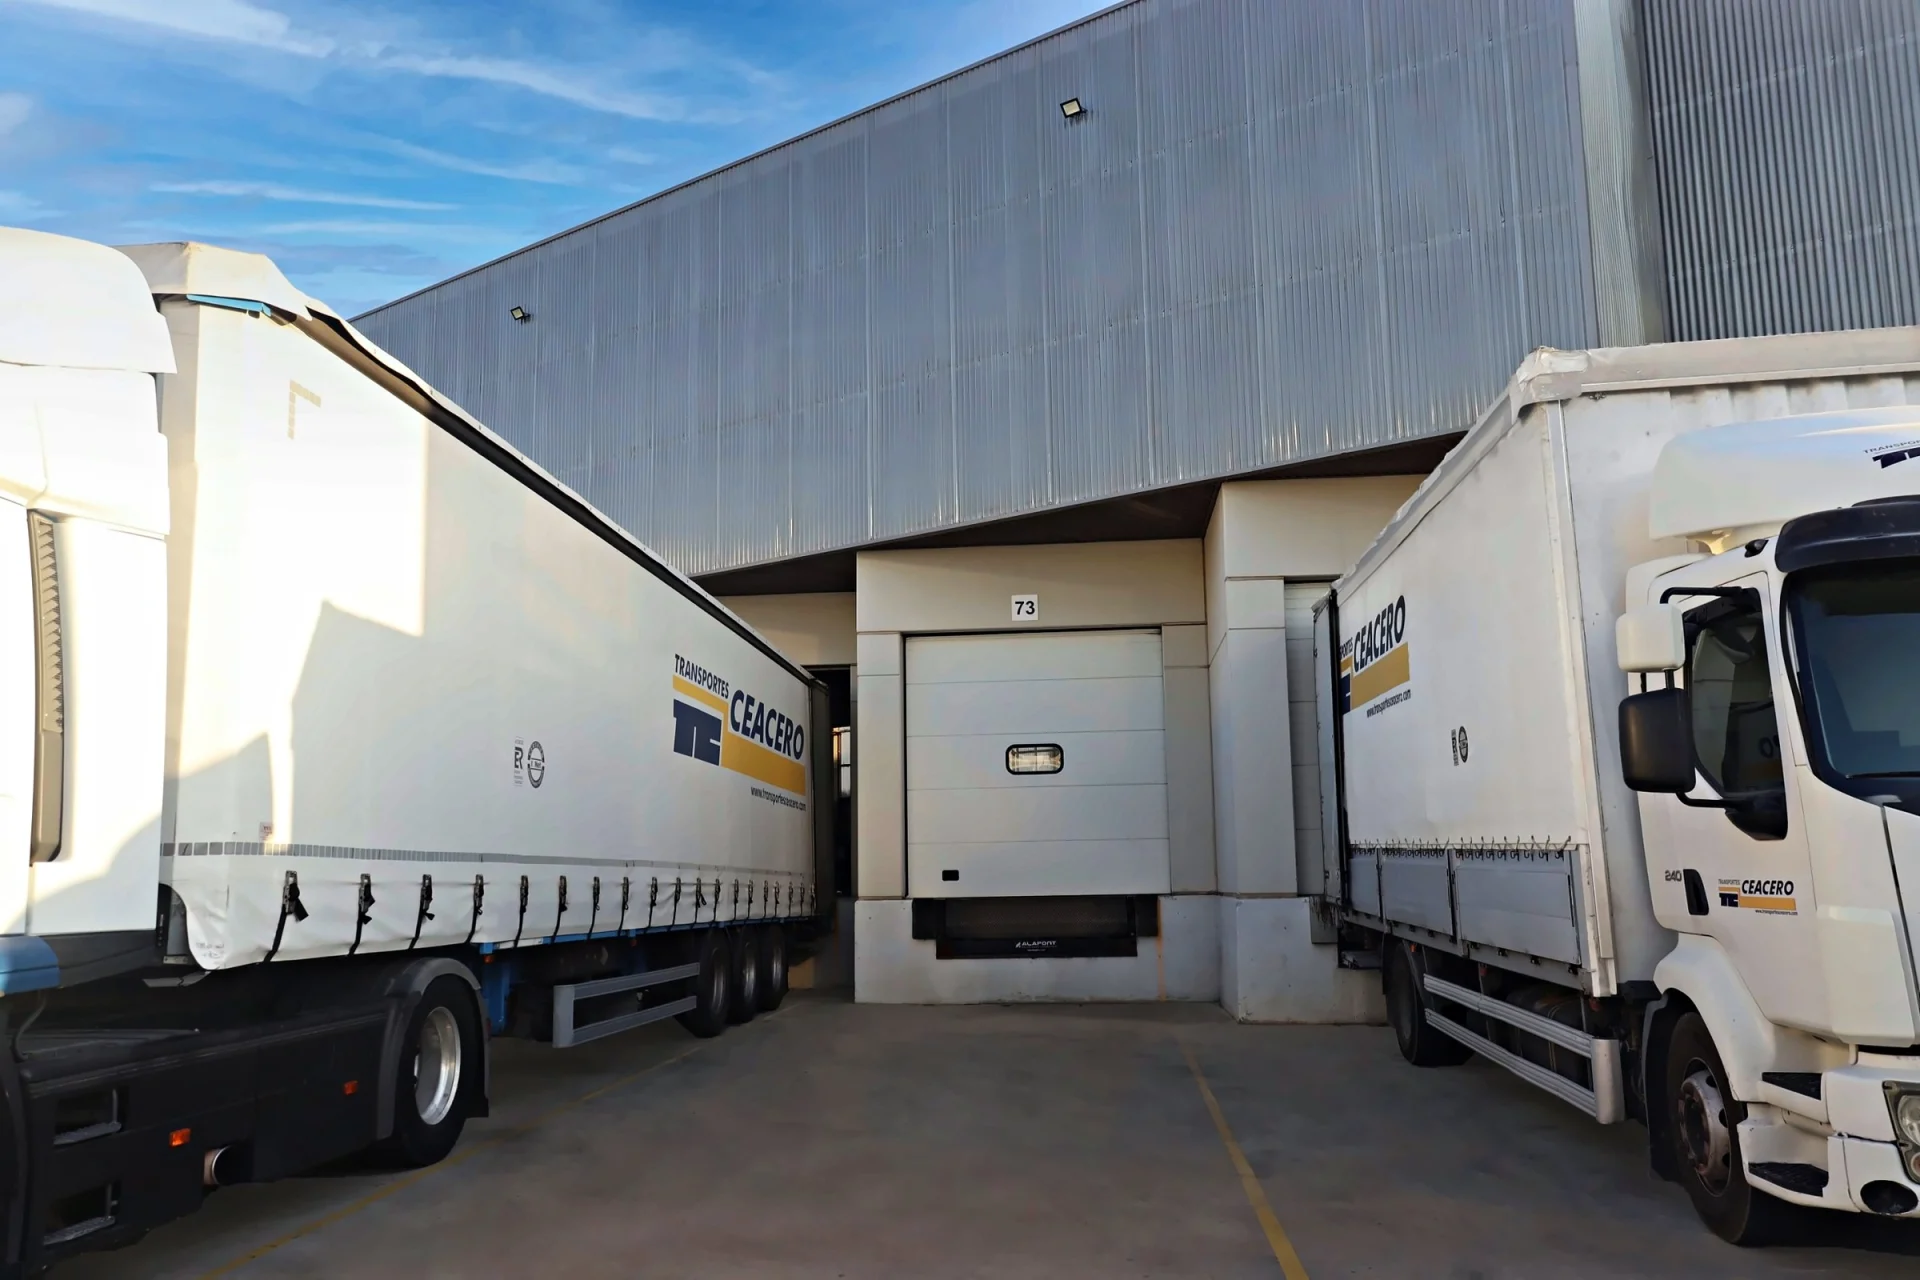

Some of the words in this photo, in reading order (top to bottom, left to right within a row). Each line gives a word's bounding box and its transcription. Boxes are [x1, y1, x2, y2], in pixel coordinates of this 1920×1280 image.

[1015, 600, 1035, 615] 73
[1354, 595, 1405, 673] CEACERO
[675, 654, 729, 699] TRANSPORTES
[730, 689, 804, 760] CEACERO
[1664, 869, 1682, 882] 240
[1742, 879, 1794, 896] CEACERO
